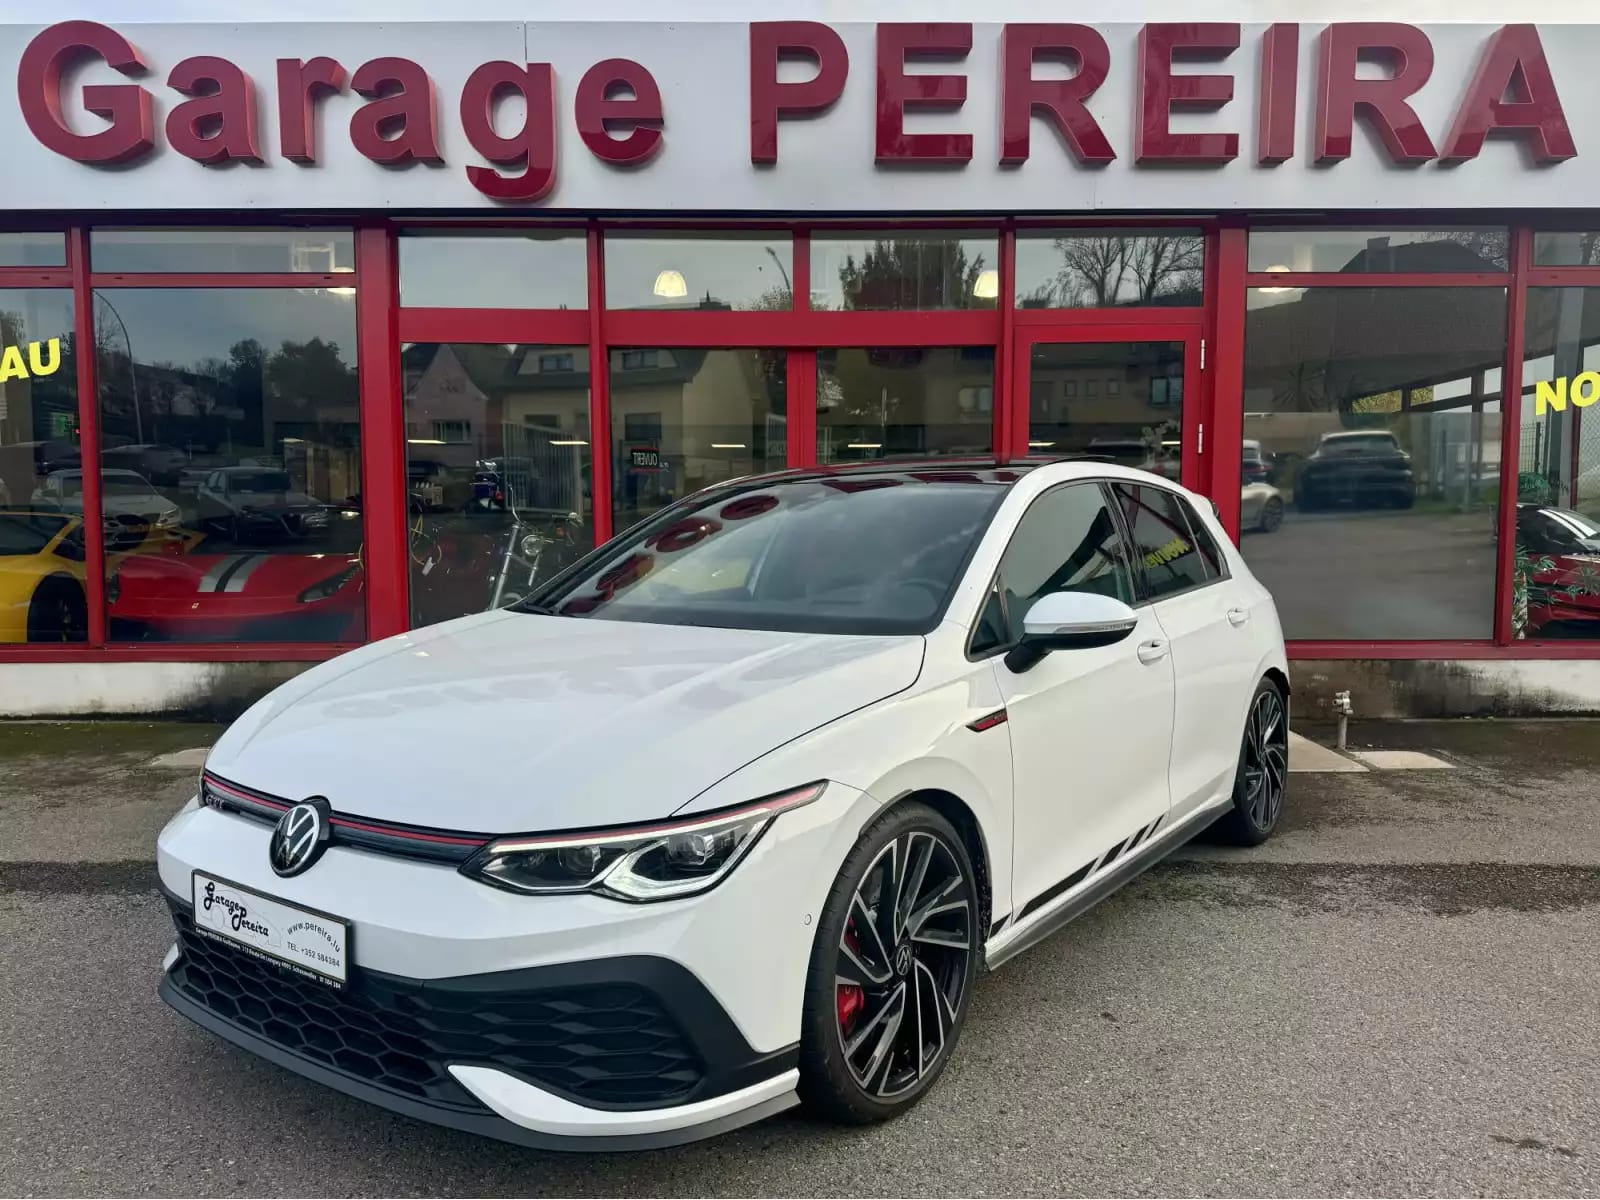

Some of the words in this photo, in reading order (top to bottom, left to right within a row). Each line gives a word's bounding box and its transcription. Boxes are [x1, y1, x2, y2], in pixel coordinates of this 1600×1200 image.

[17, 20, 664, 203] Garage
[749, 21, 1578, 165] PEREIRA
[0, 338, 60, 383] AU
[1535, 371, 1600, 416] NO
[203, 881, 240, 916] Garage
[231, 905, 269, 937] Pereira
[287, 922, 341, 953] www.pereira.lu
